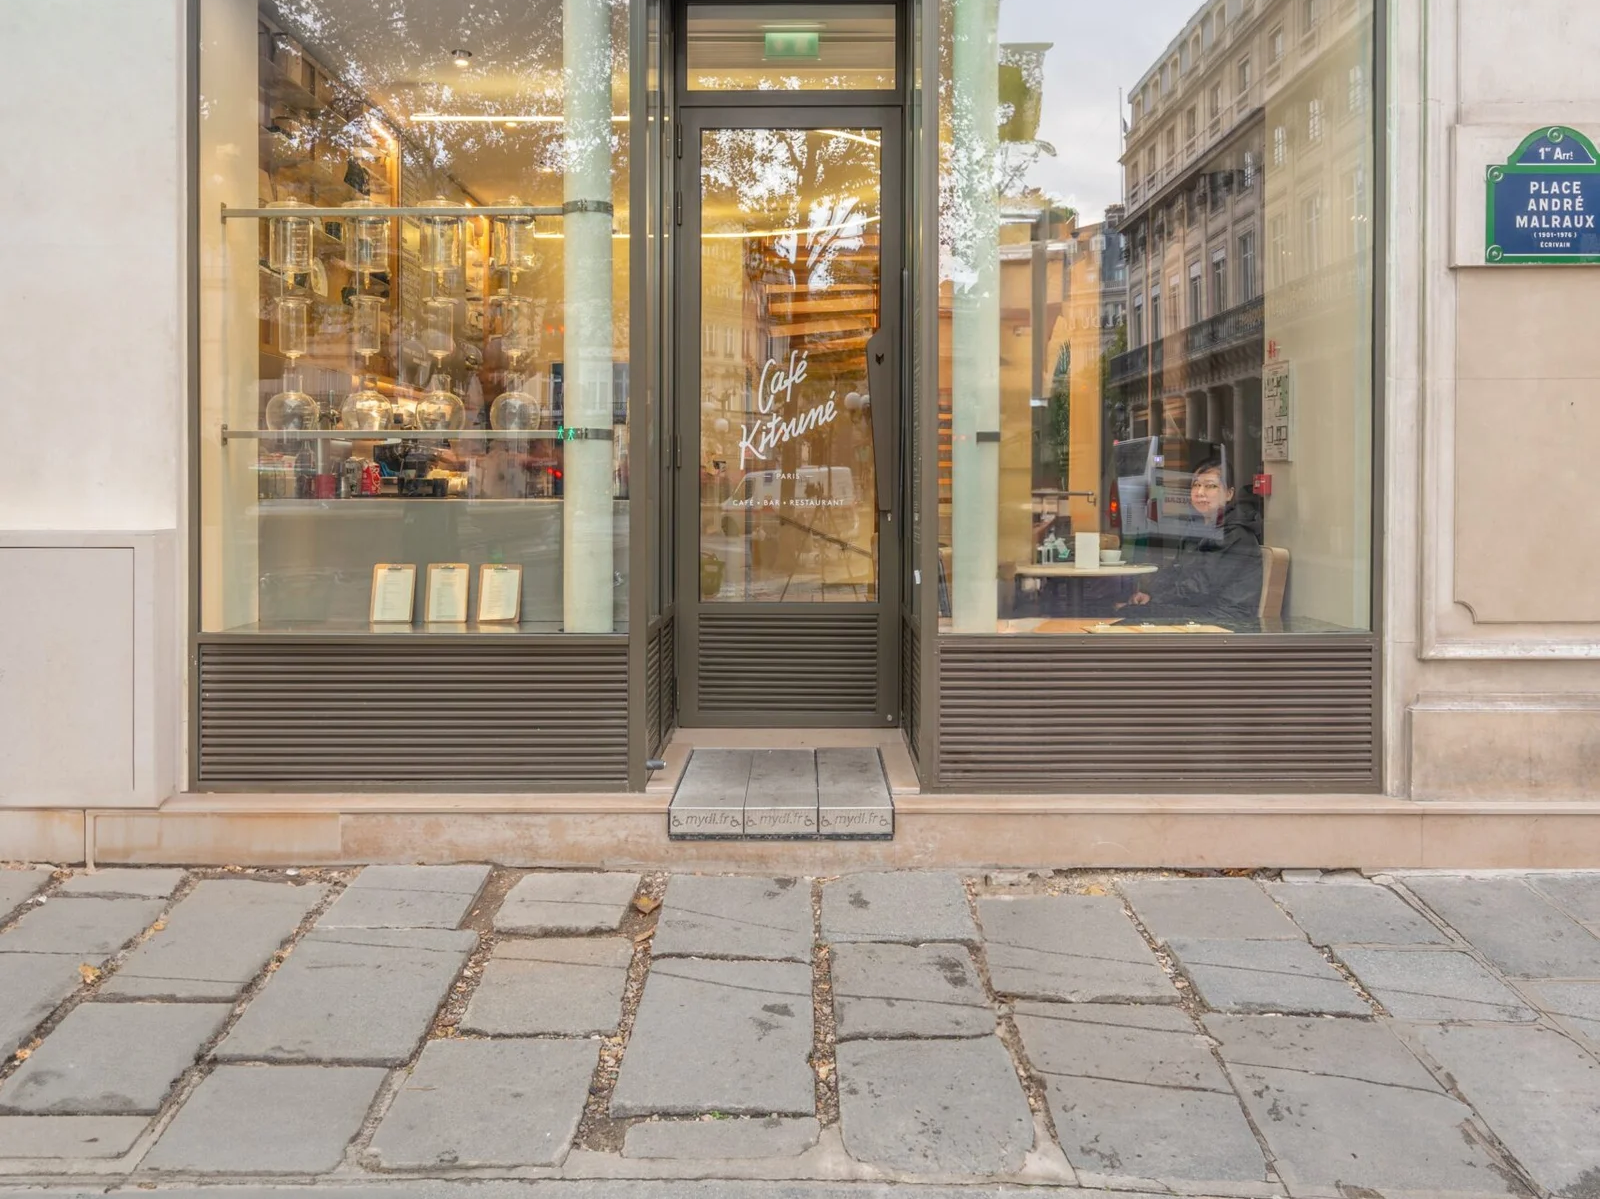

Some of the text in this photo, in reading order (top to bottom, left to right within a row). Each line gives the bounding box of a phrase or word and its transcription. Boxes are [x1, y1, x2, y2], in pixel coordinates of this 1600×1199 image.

[1529, 181, 1581, 194] PLACE
[1527, 196, 1585, 211] ANDRÉ
[1515, 215, 1595, 228] MALRAUX
[758, 350, 808, 414] Café
[738, 390, 838, 471] Kitsuné
